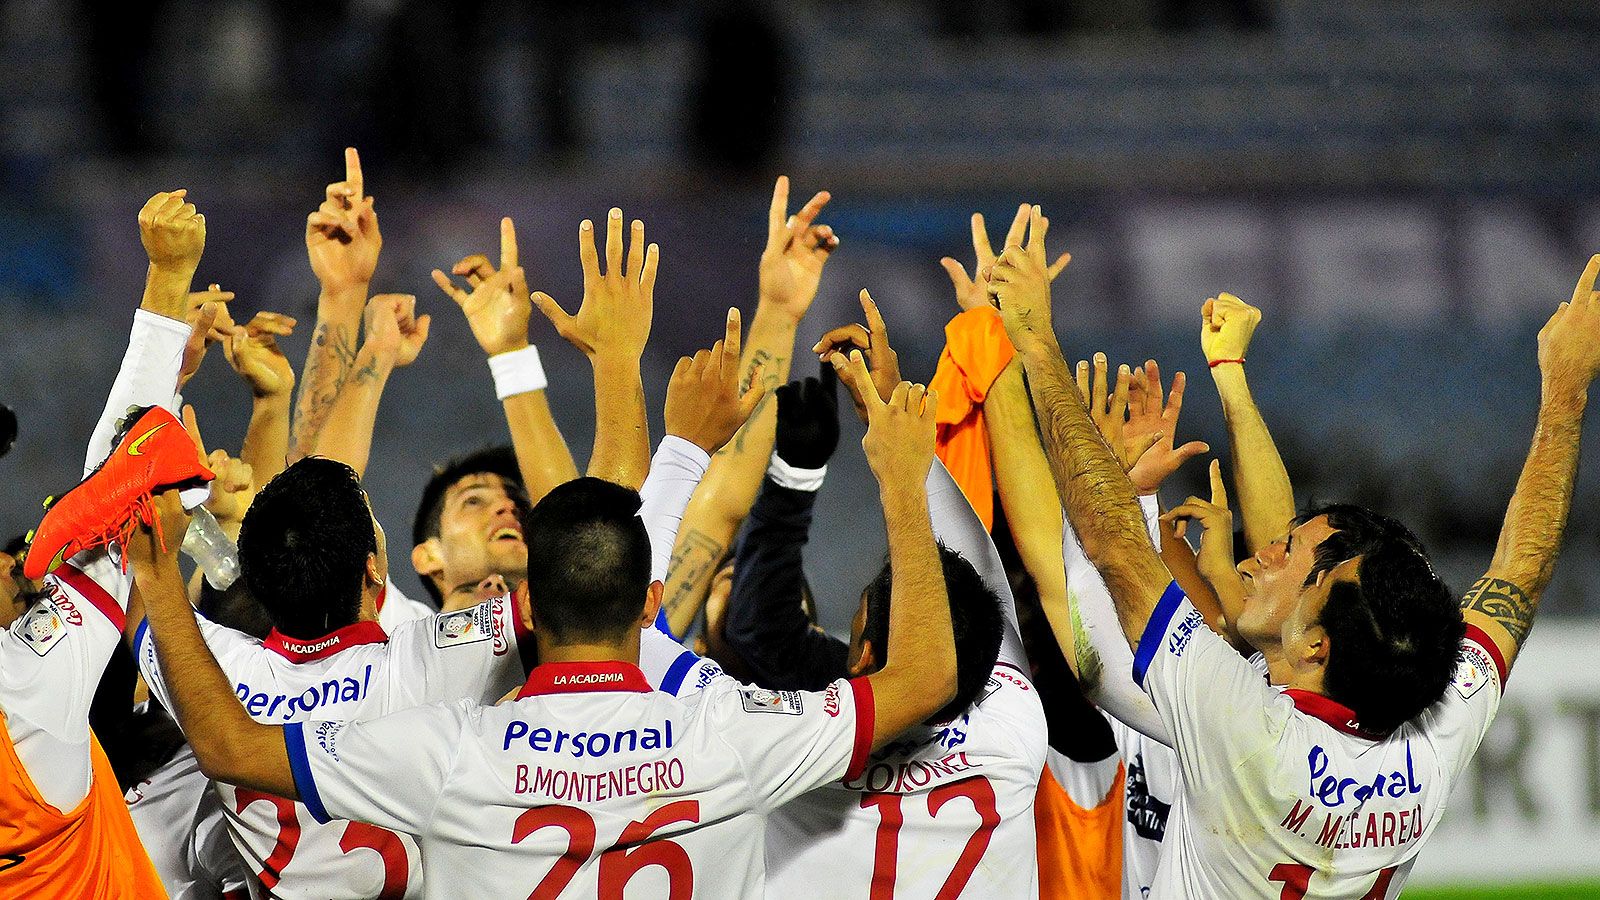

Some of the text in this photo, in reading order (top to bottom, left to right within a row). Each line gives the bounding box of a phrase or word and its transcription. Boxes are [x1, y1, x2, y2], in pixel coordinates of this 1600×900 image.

[290, 635, 340, 654] ACADEMIA
[553, 672, 624, 685] LA ACADEMIA
[503, 720, 673, 758] Personal
[1345, 719, 1360, 730] LA
[514, 757, 685, 802] B.MONTENEGRO
[859, 774, 1001, 900] 12
[1280, 798, 1315, 838] M.
[511, 799, 700, 900] 26
